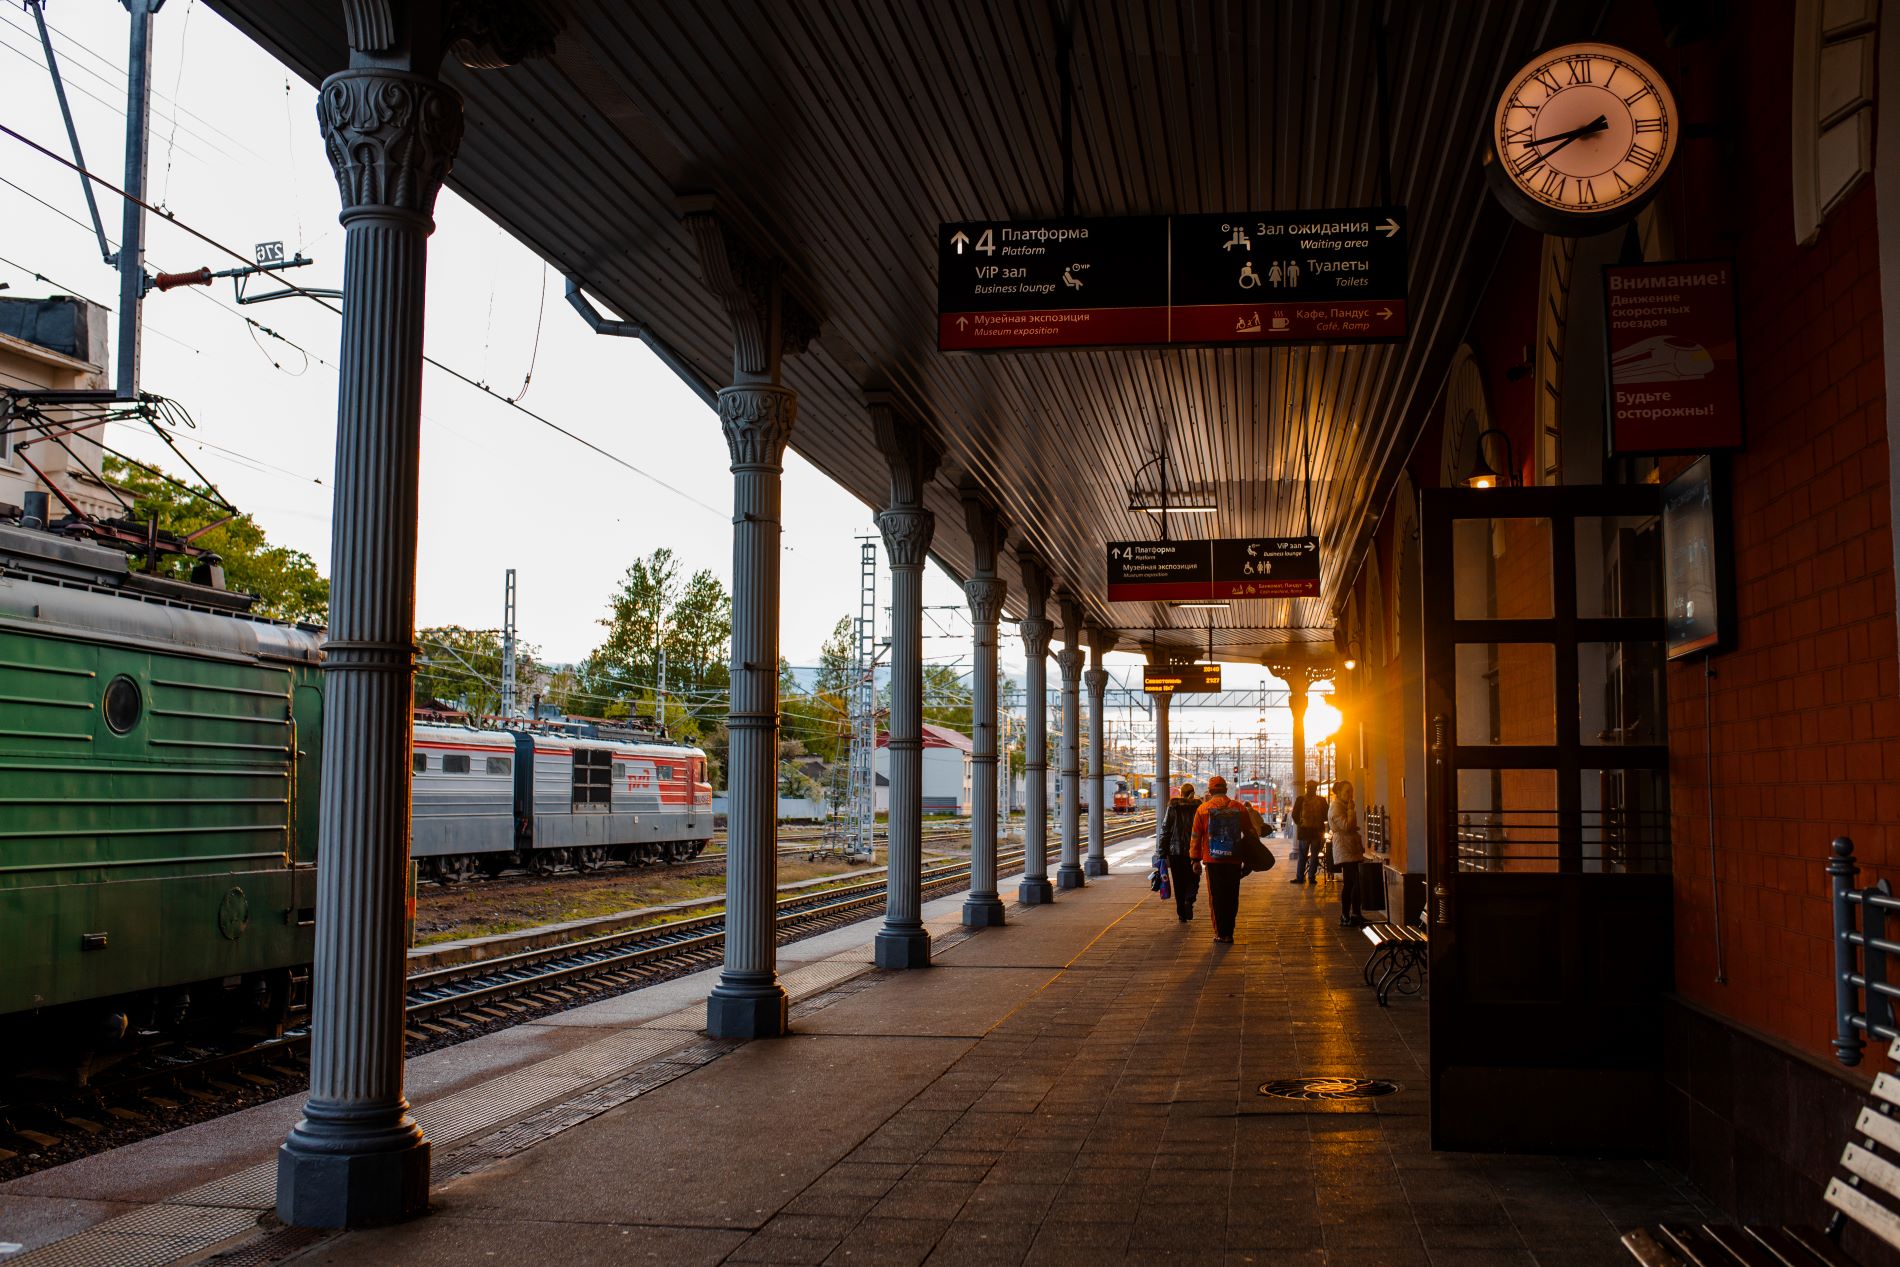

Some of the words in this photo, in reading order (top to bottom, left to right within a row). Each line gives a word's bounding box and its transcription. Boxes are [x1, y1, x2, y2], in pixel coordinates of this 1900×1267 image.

[1257, 222, 1284, 236] Зал
[1288, 222, 1369, 236] ожидания
[975, 229, 996, 256] 4
[1002, 227, 1089, 243] Платформа
[1300, 240, 1342, 250] Waiting
[1344, 240, 1368, 248] area
[1002, 246, 1046, 256] Platform
[975, 266, 998, 278] ViP
[1002, 268, 1026, 278] зал
[1307, 260, 1369, 275] Туалеты
[1336, 277, 1368, 287] Toilets
[1610, 270, 1727, 290] Внимание!
[974, 283, 1016, 294] Business
[1020, 282, 1056, 294] lounge
[1612, 294, 1680, 306] Движение
[1296, 310, 1328, 320] Кафе,
[1330, 308, 1369, 319] Пандус
[1612, 306, 1690, 318] скоростных
[974, 314, 1026, 325] Музейная
[1029, 314, 1090, 322] экспозиция
[1612, 319, 1668, 330] поездов
[974, 328, 1012, 336] Museum
[1014, 326, 1058, 336] exposition
[1342, 322, 1370, 332] Ramp
[1616, 391, 1672, 405] Будьте
[1617, 404, 1714, 420] осторожны!
[1122, 546, 1134, 560] 4
[1135, 546, 1176, 554] Платформа
[1122, 564, 1156, 572] Музейная
